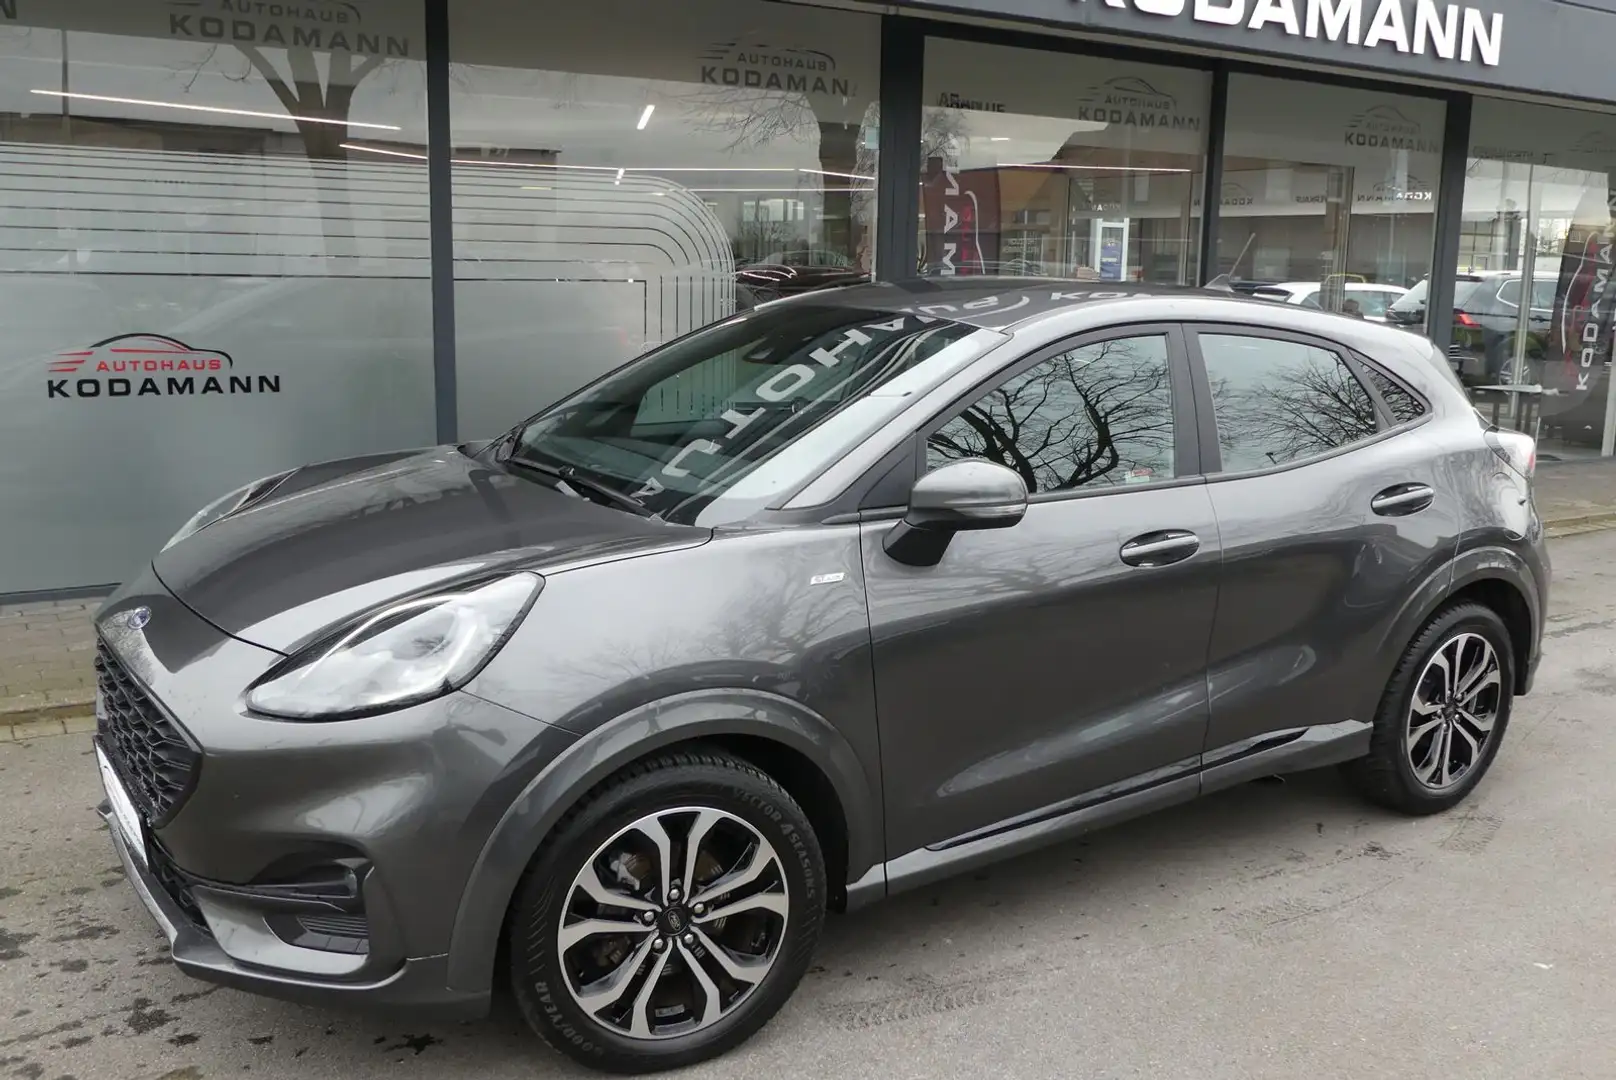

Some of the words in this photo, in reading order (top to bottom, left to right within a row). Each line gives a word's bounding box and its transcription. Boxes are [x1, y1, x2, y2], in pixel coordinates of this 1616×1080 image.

[169, 12, 410, 57] KODAMANN
[1072, 0, 1504, 66] AMANN
[1078, 105, 1201, 132] KODAMANN
[96, 359, 222, 372] AUTOHAUS
[47, 375, 281, 398] KODAMANN
